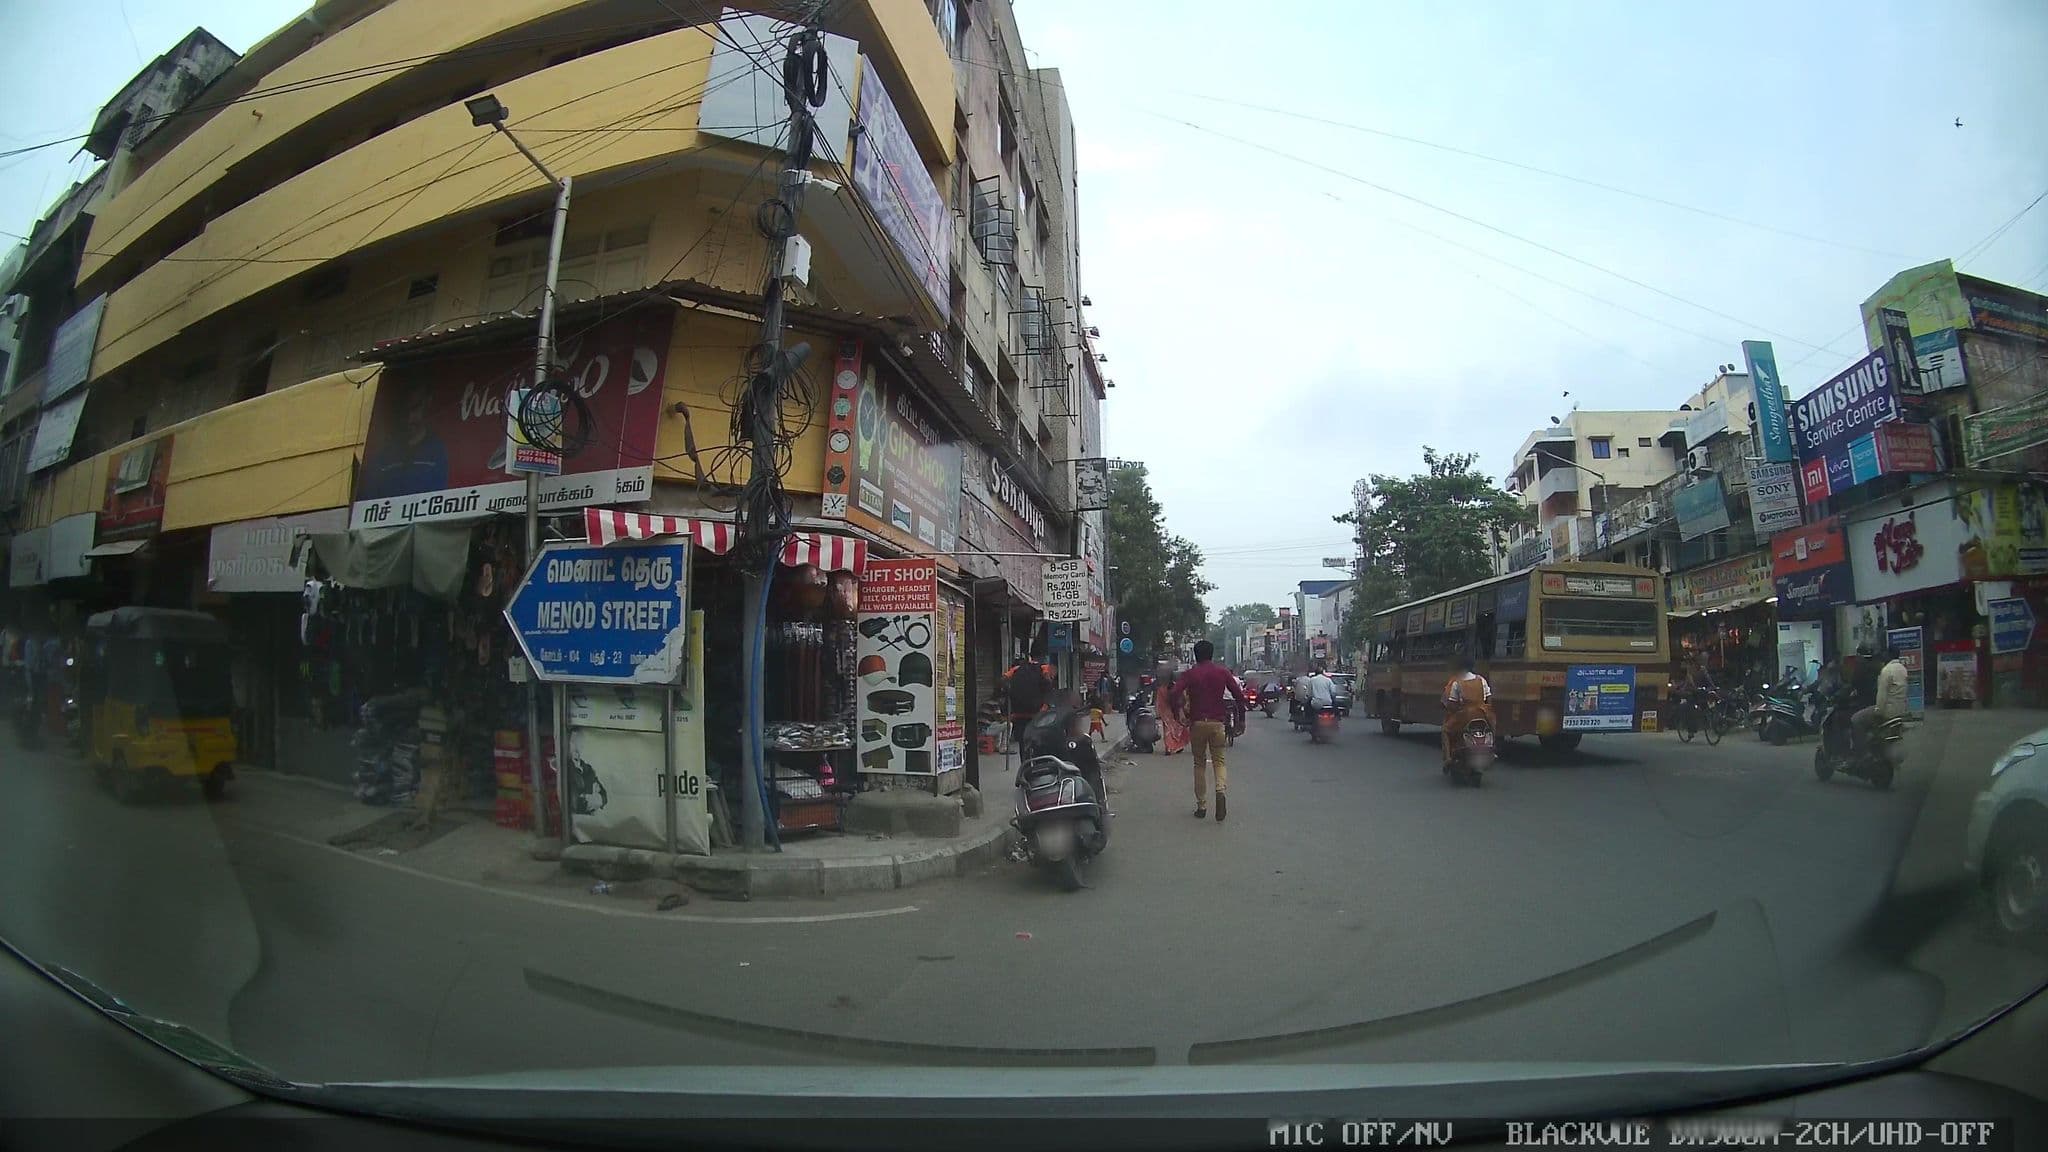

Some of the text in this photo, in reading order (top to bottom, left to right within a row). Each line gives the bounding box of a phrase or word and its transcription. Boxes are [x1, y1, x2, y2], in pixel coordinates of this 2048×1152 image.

[1797, 356, 1888, 432] SAMSUNG
[1806, 396, 1886, 449] Service Centre
[888, 421, 945, 491] GIFT SHOP
[1750, 465, 1792, 480] SAMSUNG
[1828, 459, 1849, 474] vivo
[1756, 482, 1791, 496] SONY
[991, 457, 1044, 538] Sandhya
[363, 500, 391, 523] ரிச்
[401, 490, 480, 518] புட்வேர்
[1766, 508, 1799, 520] MOTOROLA
[547, 555, 673, 592] மெனாட் தெரு
[1050, 561, 1078, 572] 8-GB
[860, 567, 934, 582] GIFT SHOP
[862, 584, 931, 593] CHARGER, HEADSET
[1047, 580, 1082, 591] Rs.209/-
[907, 593, 930, 601] PURSE
[1051, 590, 1080, 600] 16-GB
[873, 603, 893, 611] WAYS
[537, 600, 672, 631] MENOD STREET
